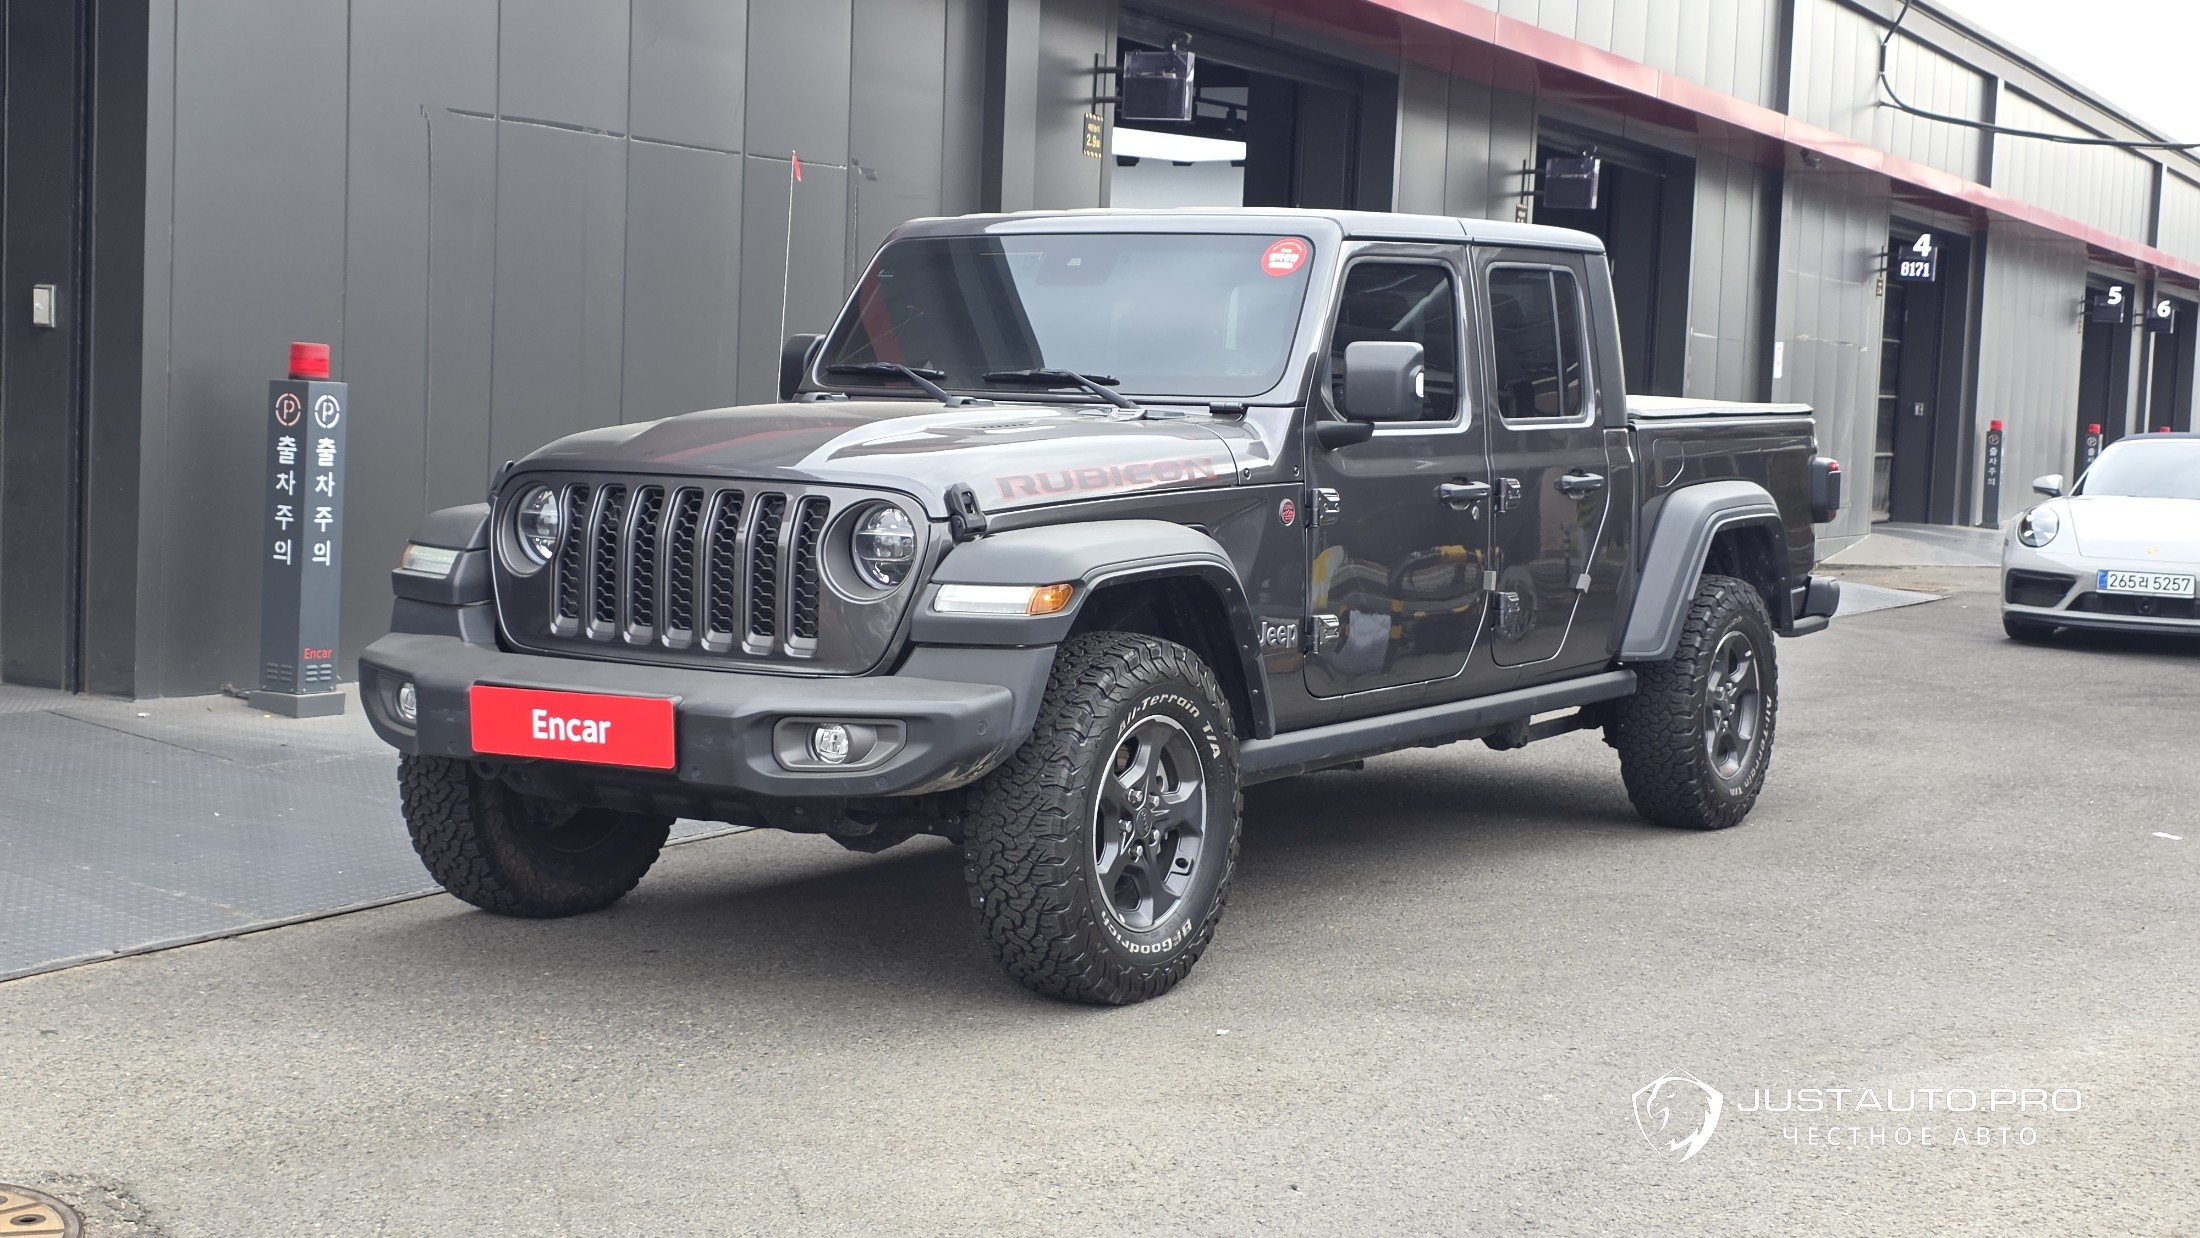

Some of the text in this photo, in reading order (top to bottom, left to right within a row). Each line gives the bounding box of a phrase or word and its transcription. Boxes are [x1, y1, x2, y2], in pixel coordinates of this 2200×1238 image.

[1912, 233, 1932, 257] 4
[1900, 261, 1930, 277] 8171
[2107, 286, 2122, 305] 5
[2157, 300, 2171, 317] 6
[995, 457, 1217, 500] RUBICON
[273, 435, 297, 565] 출차주의
[312, 437, 336, 566] 출차주의
[2153, 576, 2190, 592] 5257
[1257, 621, 1298, 649] Jeep
[304, 648, 332, 660] Encar
[532, 708, 612, 744] Encar
[1117, 693, 1221, 760] All-Terrain T/A
[1101, 910, 1192, 954] BFGoodrich
